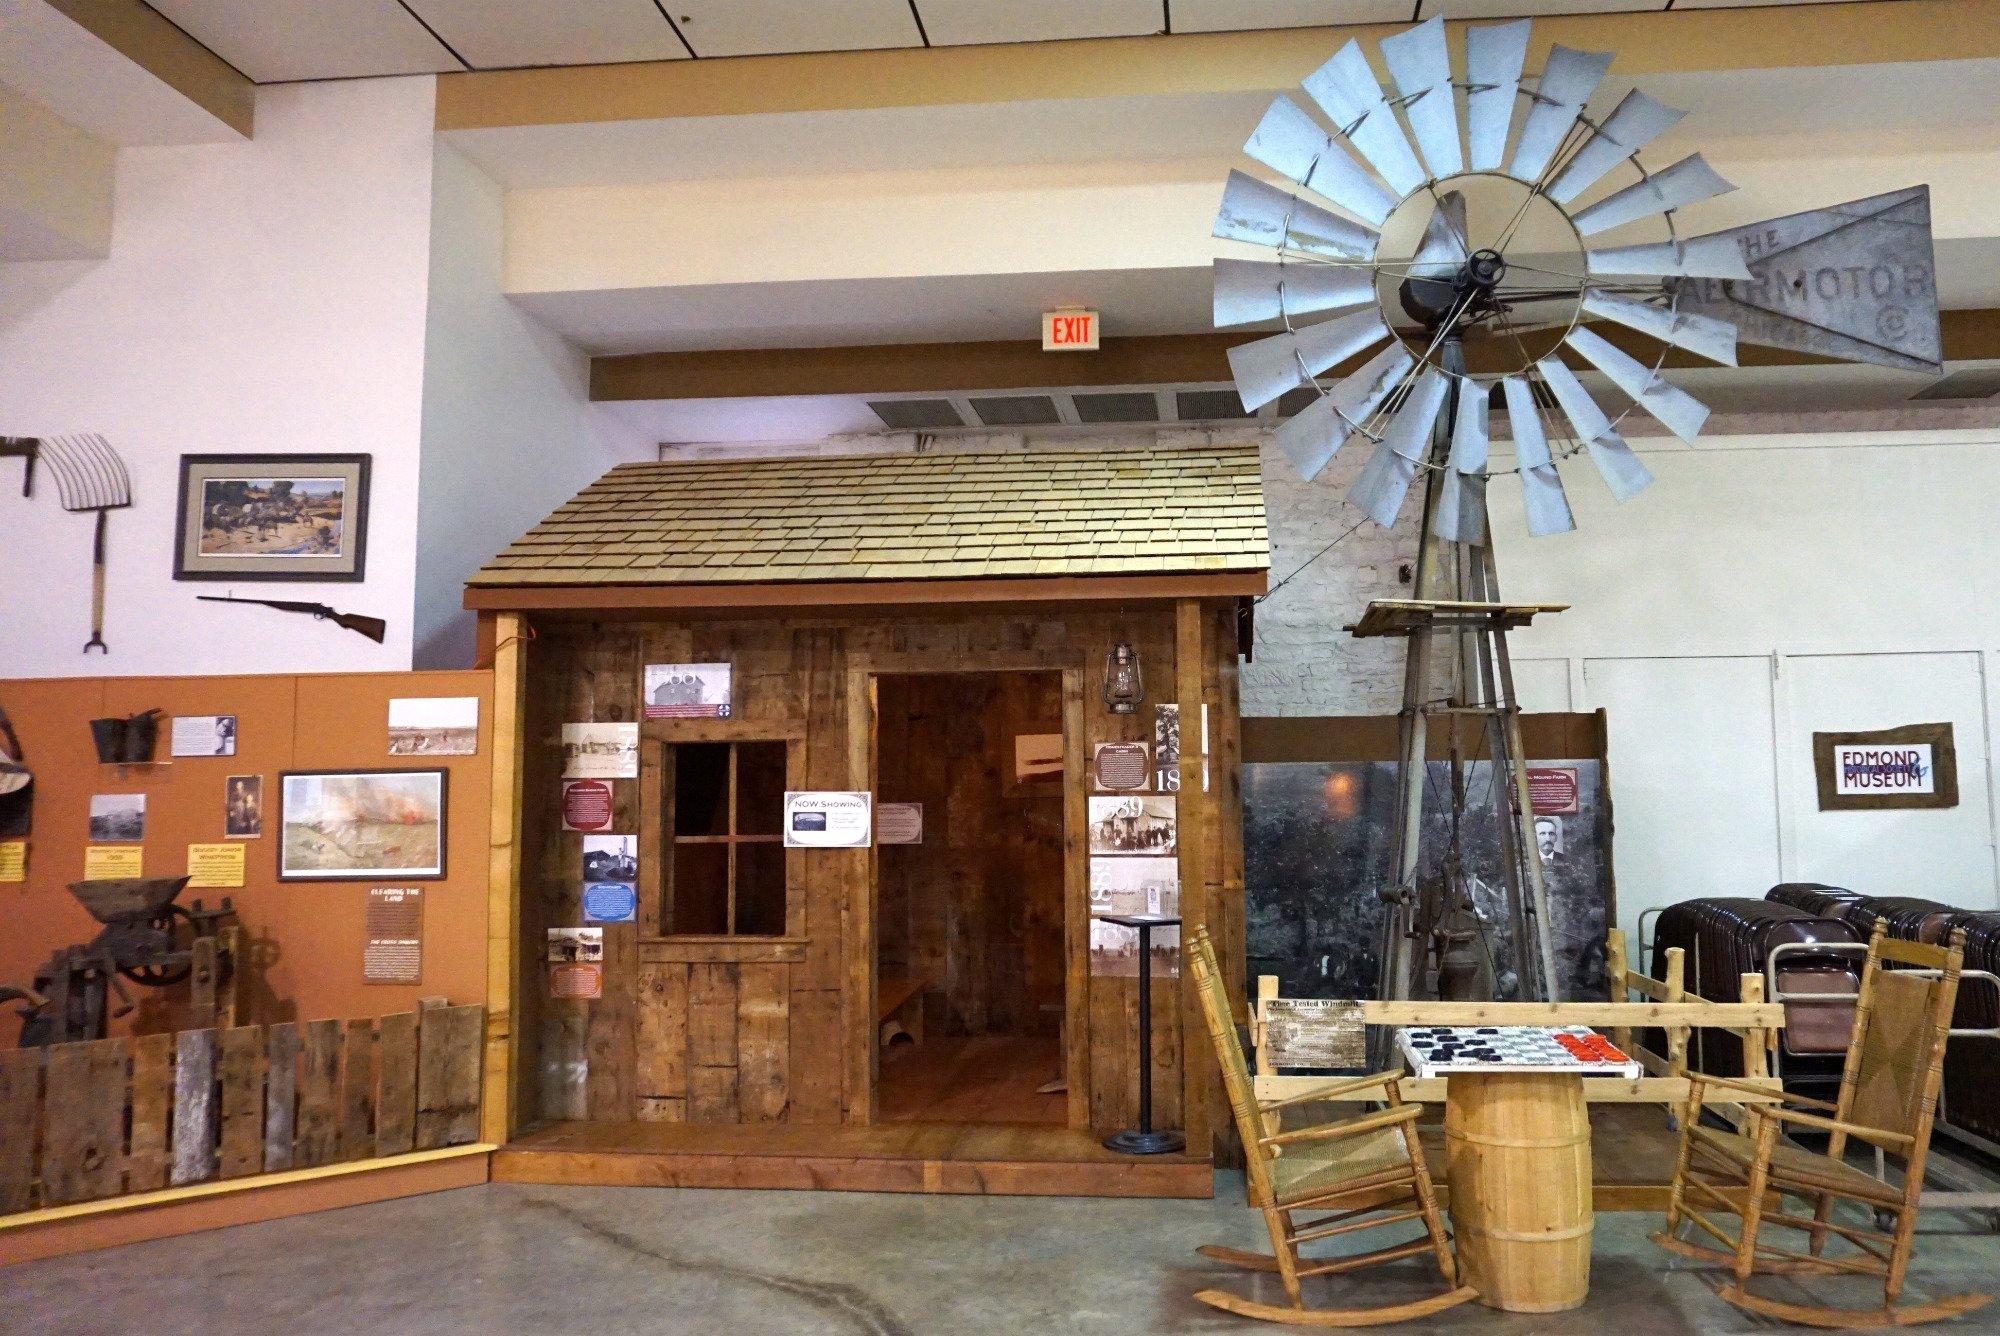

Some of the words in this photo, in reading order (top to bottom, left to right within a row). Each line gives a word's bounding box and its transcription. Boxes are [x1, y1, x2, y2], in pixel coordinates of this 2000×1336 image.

[1053, 317, 1090, 343] EXIT
[1843, 751, 1920, 765] EDMOND
[1844, 773, 1922, 787] MUSEUM
